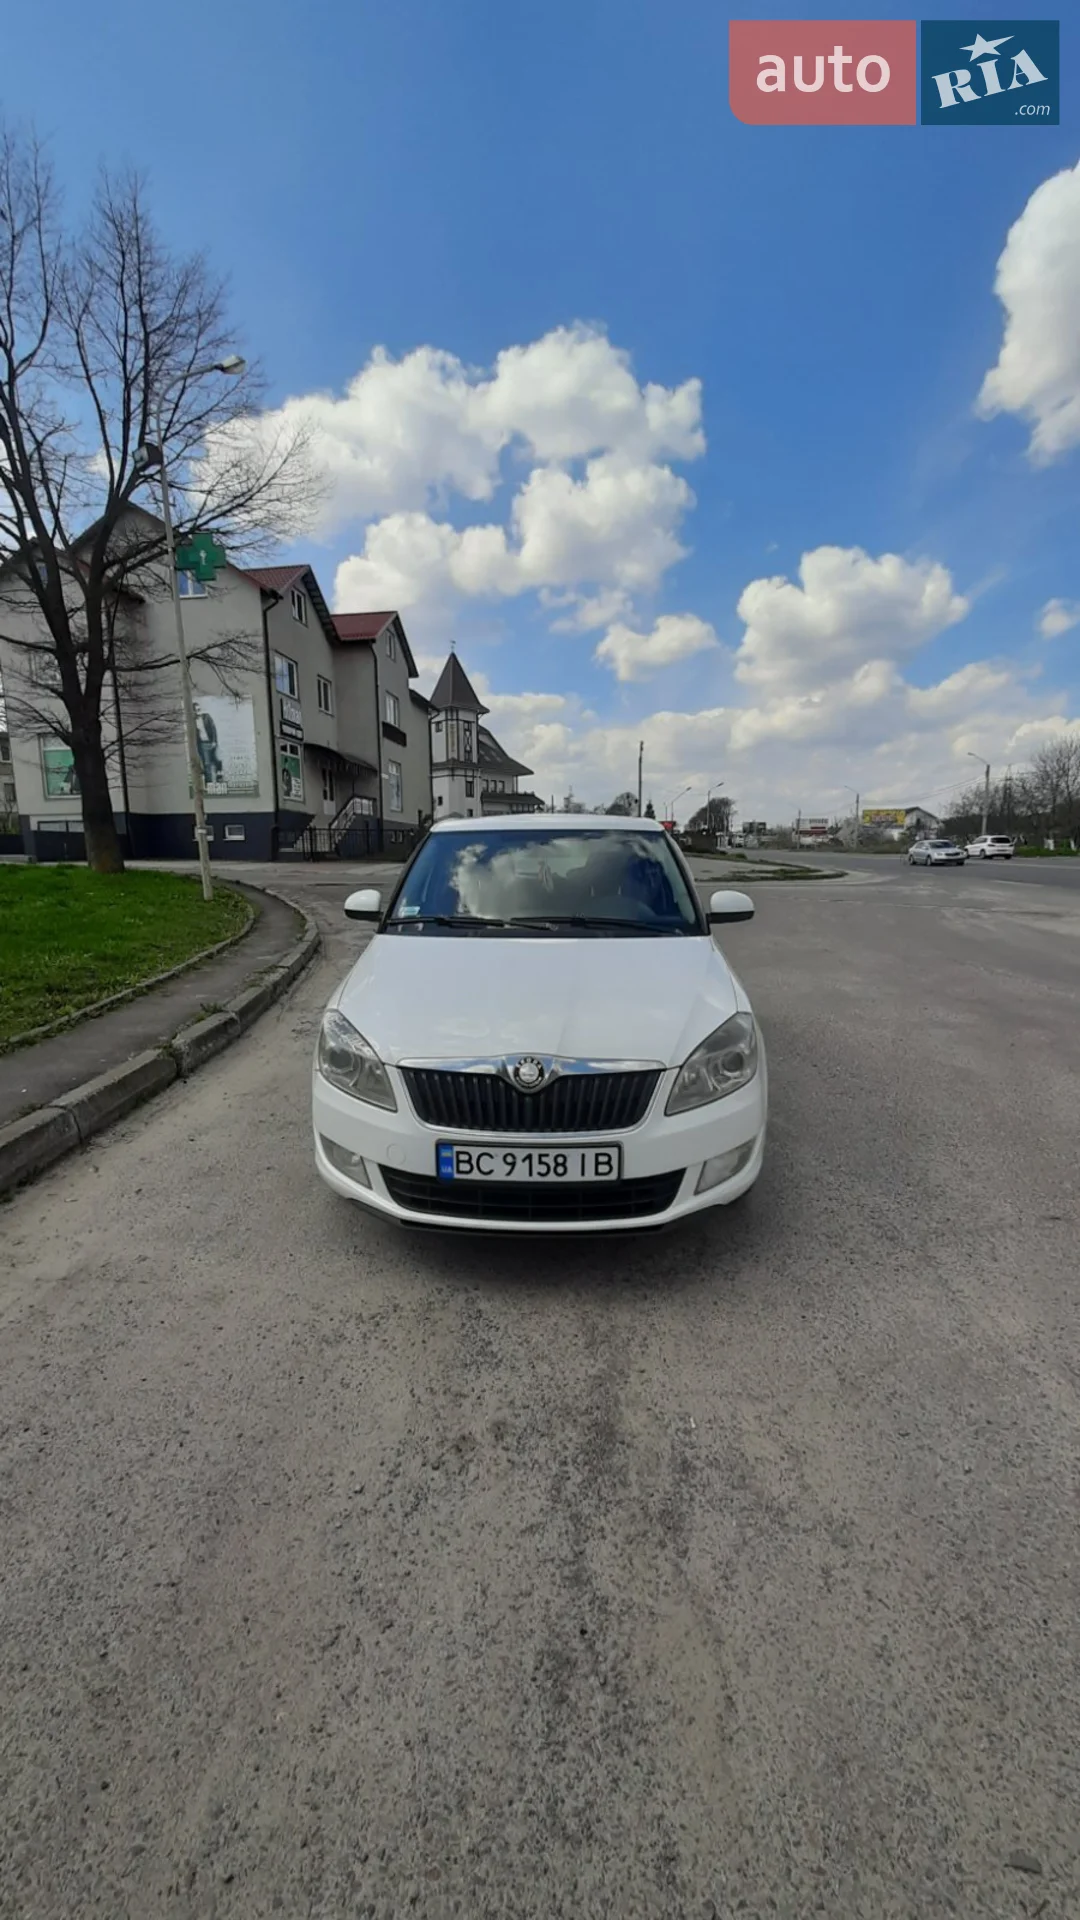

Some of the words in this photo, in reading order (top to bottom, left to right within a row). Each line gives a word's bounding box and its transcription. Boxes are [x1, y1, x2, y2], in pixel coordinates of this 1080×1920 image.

[455, 1150, 495, 1176] BC
[502, 1152, 569, 1177] 9158
[580, 1153, 614, 1177] IB
